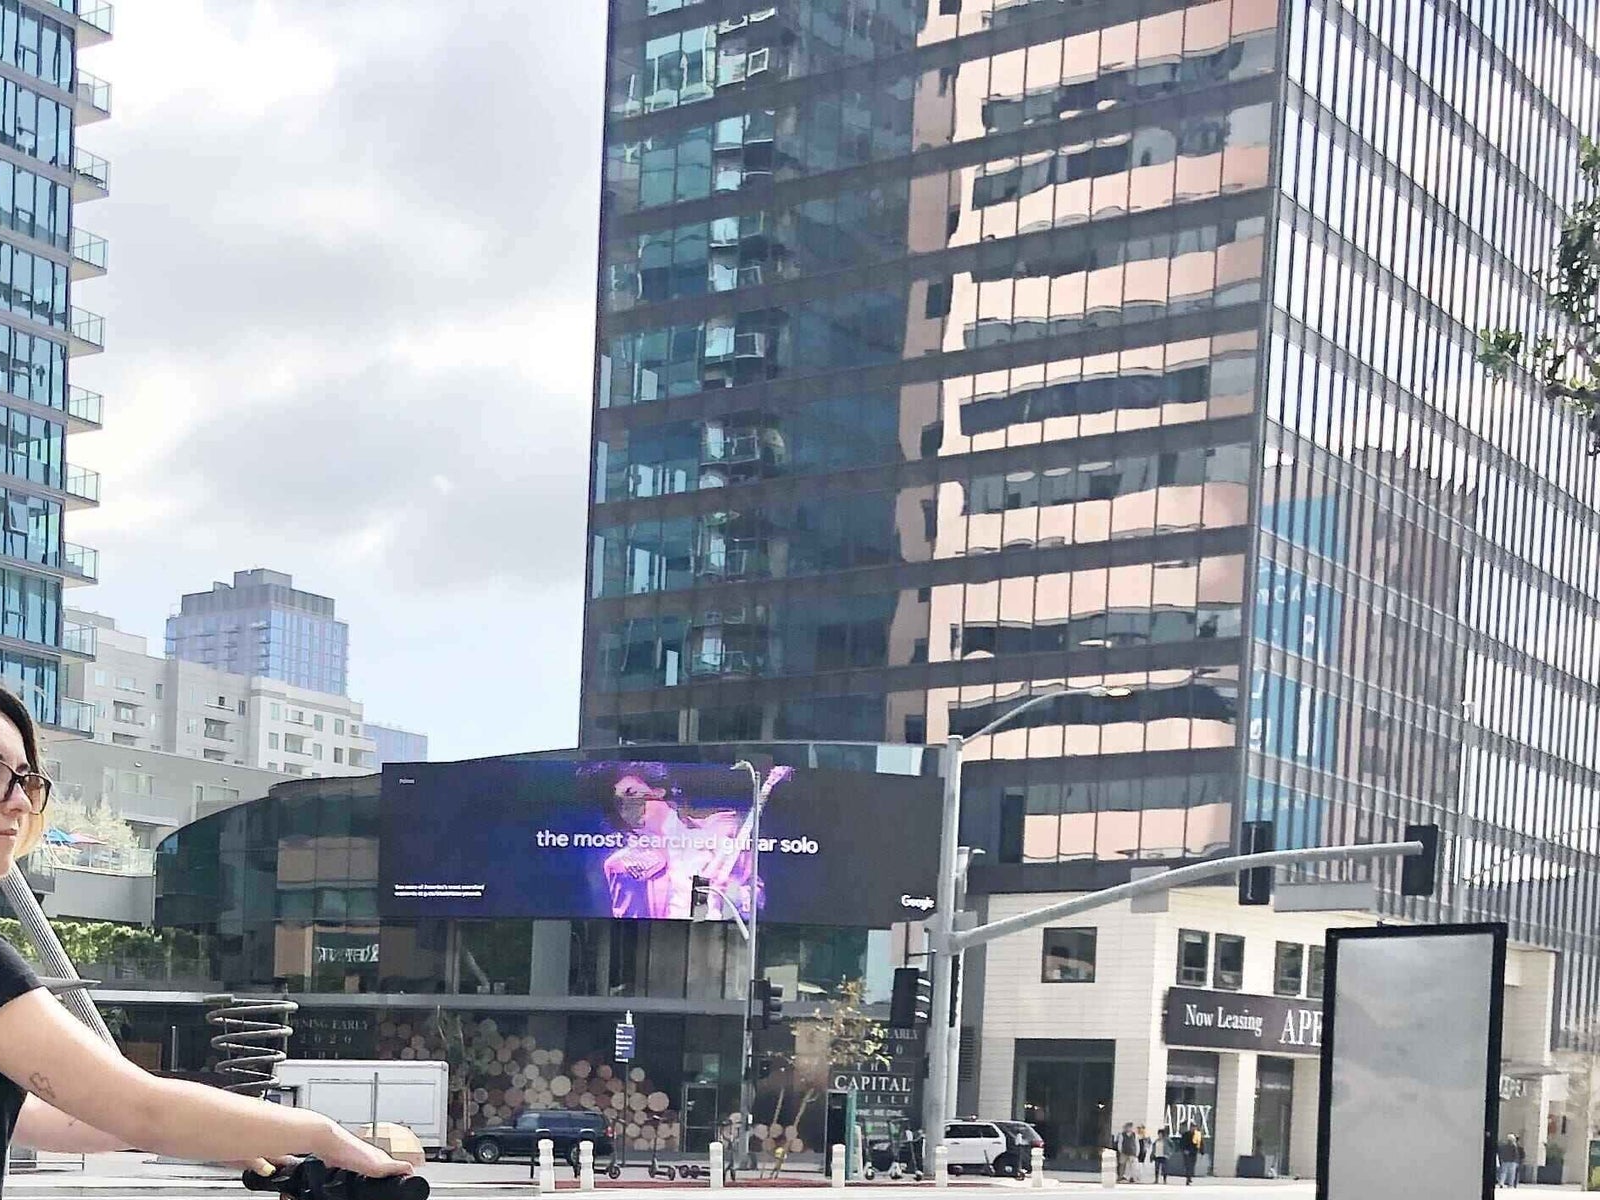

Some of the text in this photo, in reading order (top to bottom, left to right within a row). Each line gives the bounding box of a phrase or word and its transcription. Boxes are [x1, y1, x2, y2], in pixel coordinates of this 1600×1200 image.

[536, 830, 819, 856] the most searched guiar solo
[901, 894, 935, 911] Google
[1185, 1003, 1324, 1046] Now Leasing APE
[834, 1075, 911, 1092] CAPITAL
[1164, 1103, 1213, 1139] APEX
